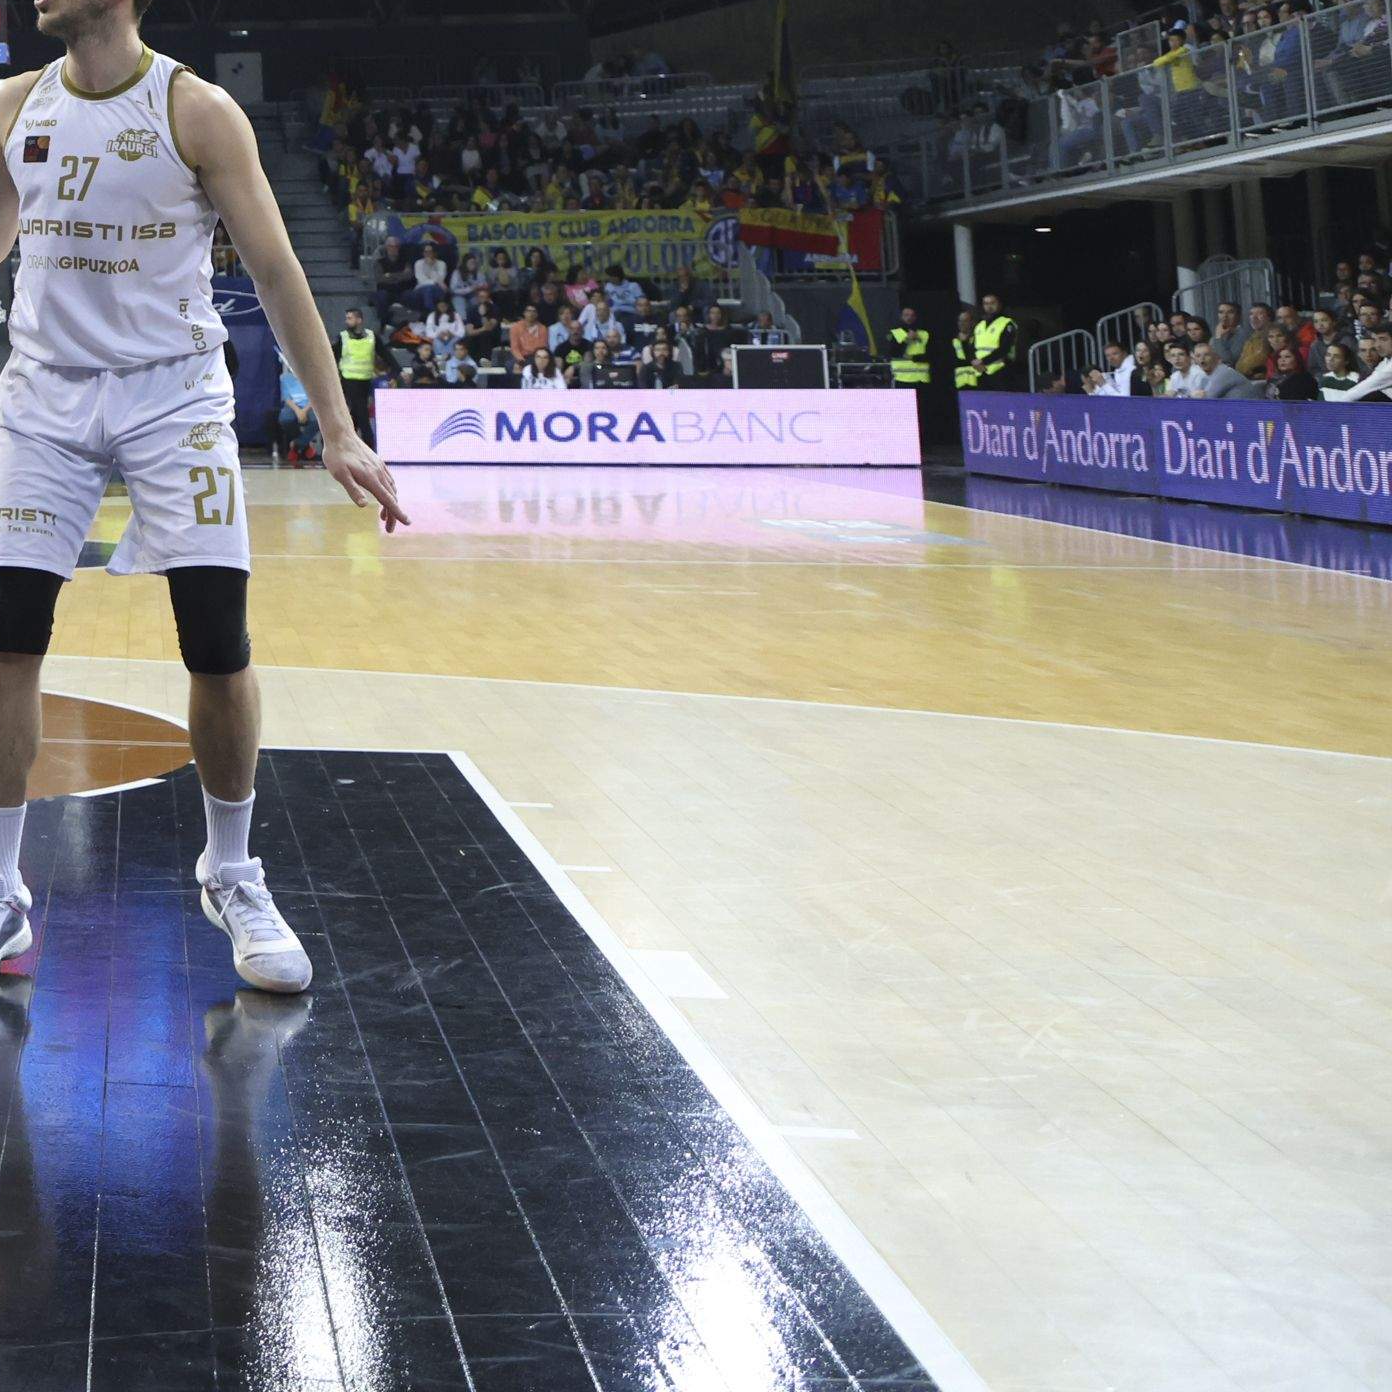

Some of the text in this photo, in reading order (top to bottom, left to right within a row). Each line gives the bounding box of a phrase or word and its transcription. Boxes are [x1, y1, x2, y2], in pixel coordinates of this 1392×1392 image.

[57, 156, 101, 202] 27
[19, 219, 177, 242] UARISTI ISB
[467, 215, 695, 242] BASQUET CLUB ANDORRA
[495, 410, 825, 444] MORABANC
[965, 409, 1149, 474] Diari d'Andorra
[1161, 419, 1237, 480] Diari
[189, 466, 236, 526] 27
